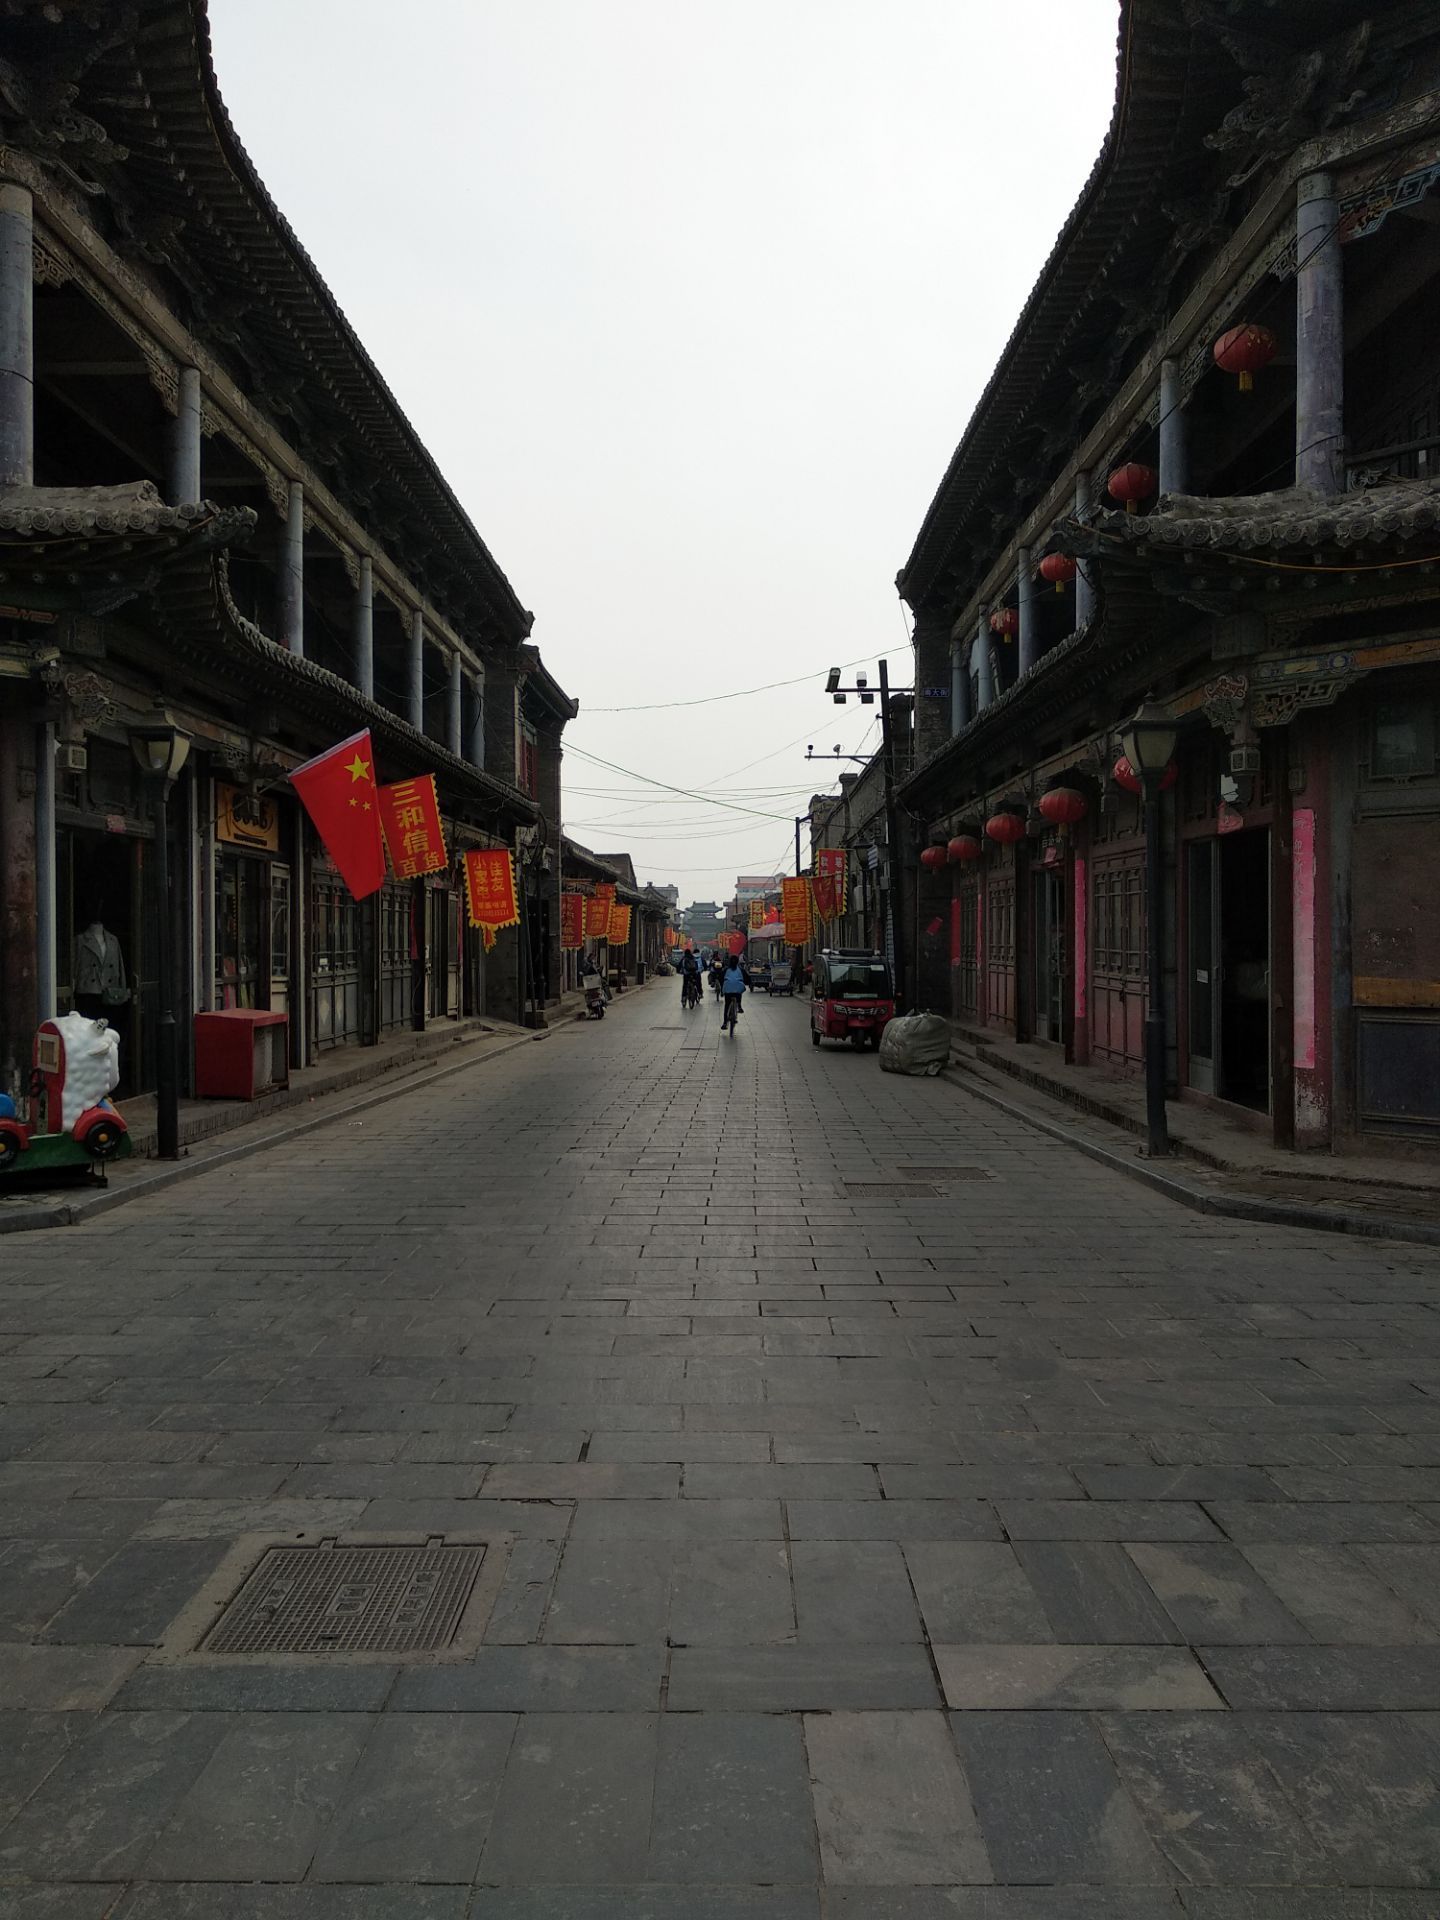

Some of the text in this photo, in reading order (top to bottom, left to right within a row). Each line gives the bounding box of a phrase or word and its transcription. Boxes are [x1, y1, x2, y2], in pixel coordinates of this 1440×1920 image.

[390, 780, 430, 853] 三和信
[399, 851, 440, 874] 百货
